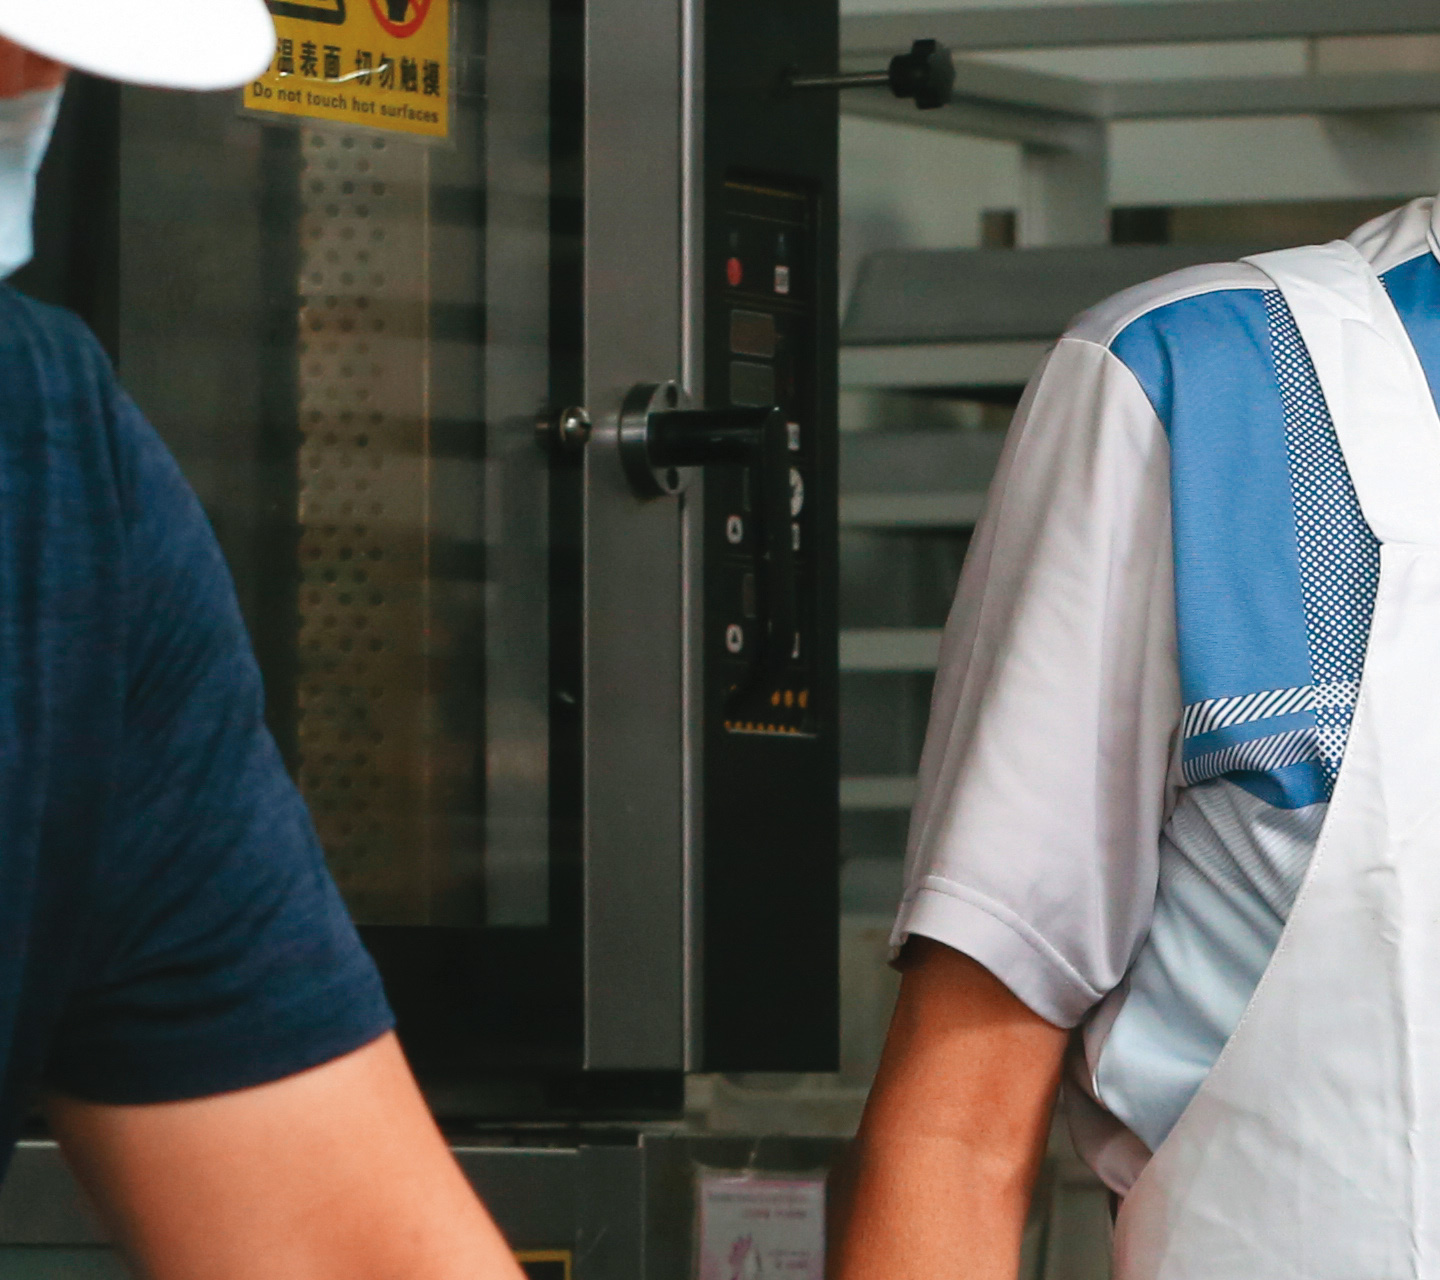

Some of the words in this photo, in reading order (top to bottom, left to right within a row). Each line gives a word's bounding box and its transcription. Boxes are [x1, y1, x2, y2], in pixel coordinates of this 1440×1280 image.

[267, 37, 341, 79] 温表面
[253, 81, 272, 98] Do
[277, 86, 302, 102] not
[307, 90, 347, 109] touch
[352, 96, 375, 114] hot
[380, 102, 439, 123] surfaces
